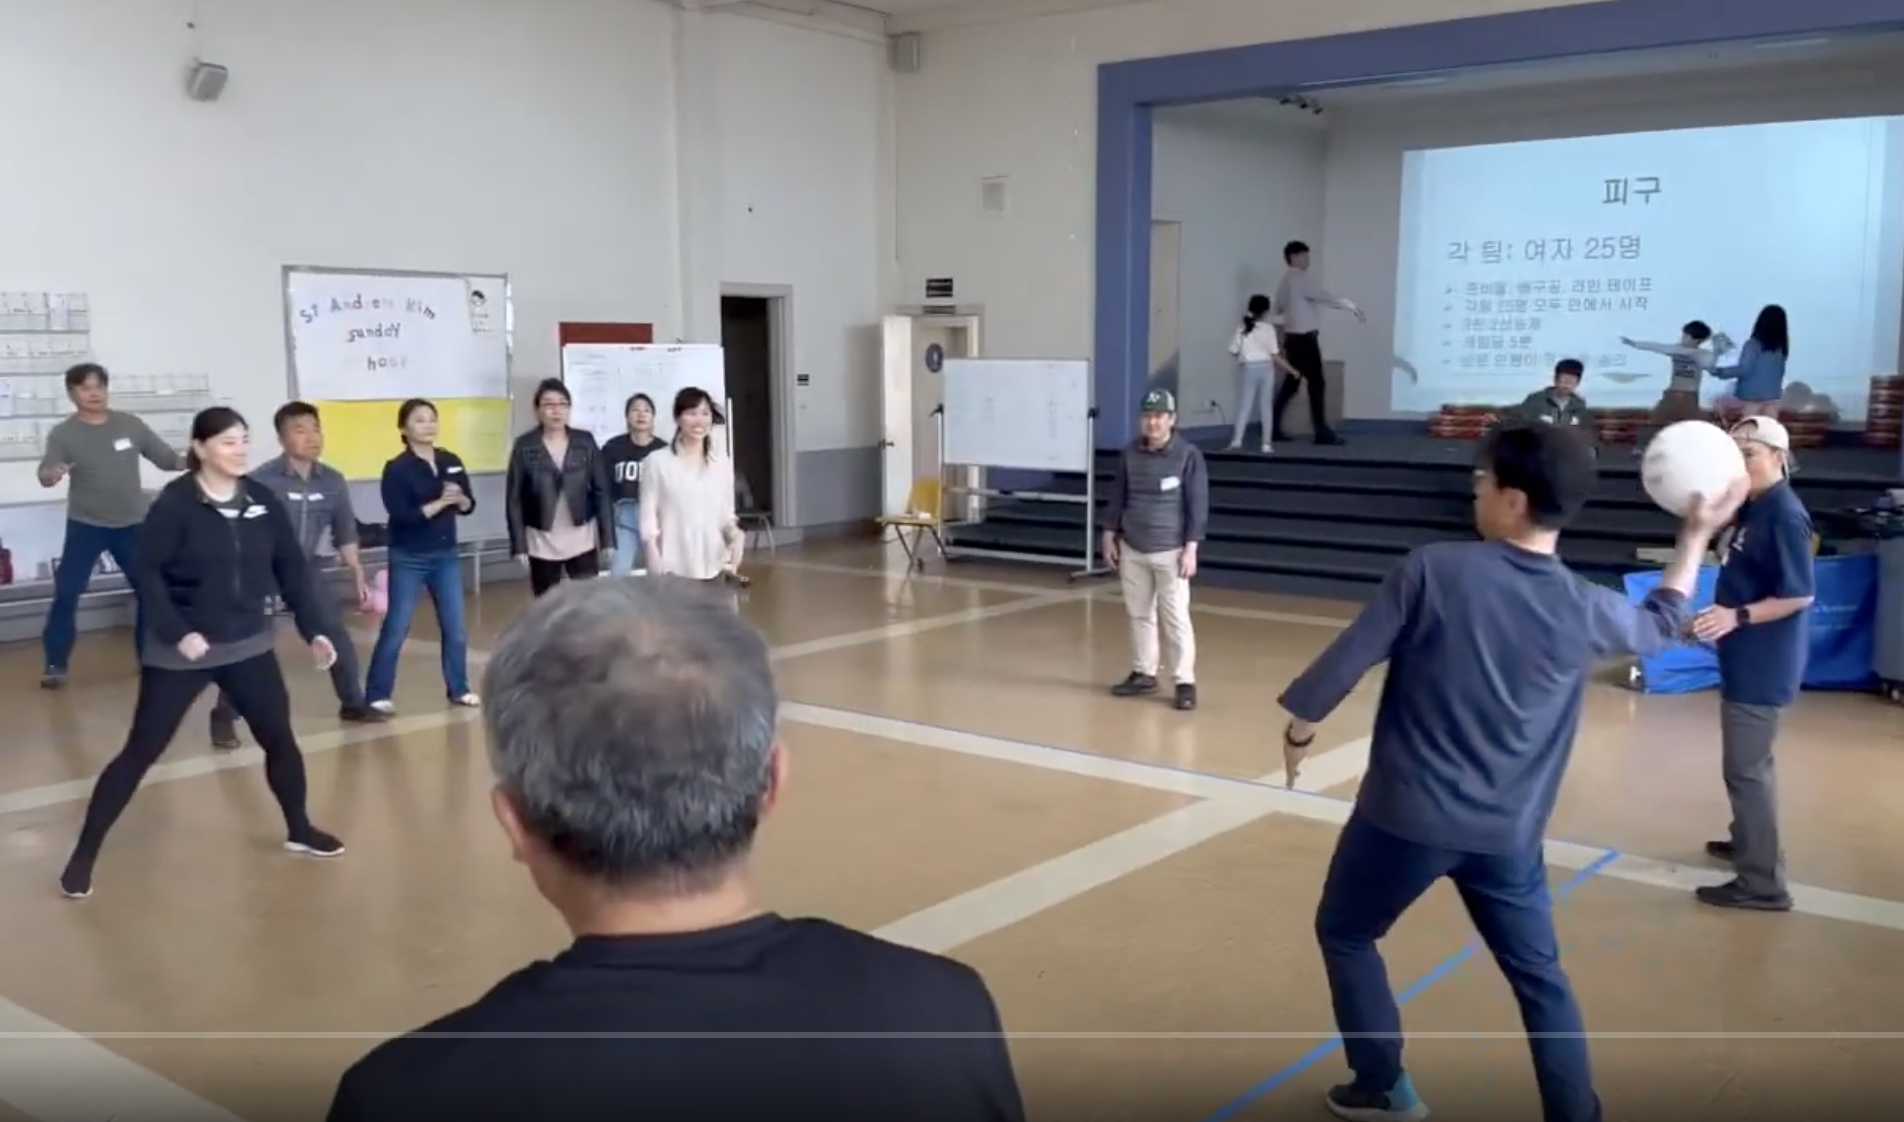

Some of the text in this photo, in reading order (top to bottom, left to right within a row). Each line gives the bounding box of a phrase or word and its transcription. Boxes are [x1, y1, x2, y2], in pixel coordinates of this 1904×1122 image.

[1602, 176, 1662, 205] 피구
[1447, 235, 1640, 264] 각 팀: 여자 25명
[1607, 276, 1653, 293] 테이프
[327, 292, 394, 312] Andew
[1567, 296, 1612, 312] 안에서
[1619, 296, 1648, 311] 시작
